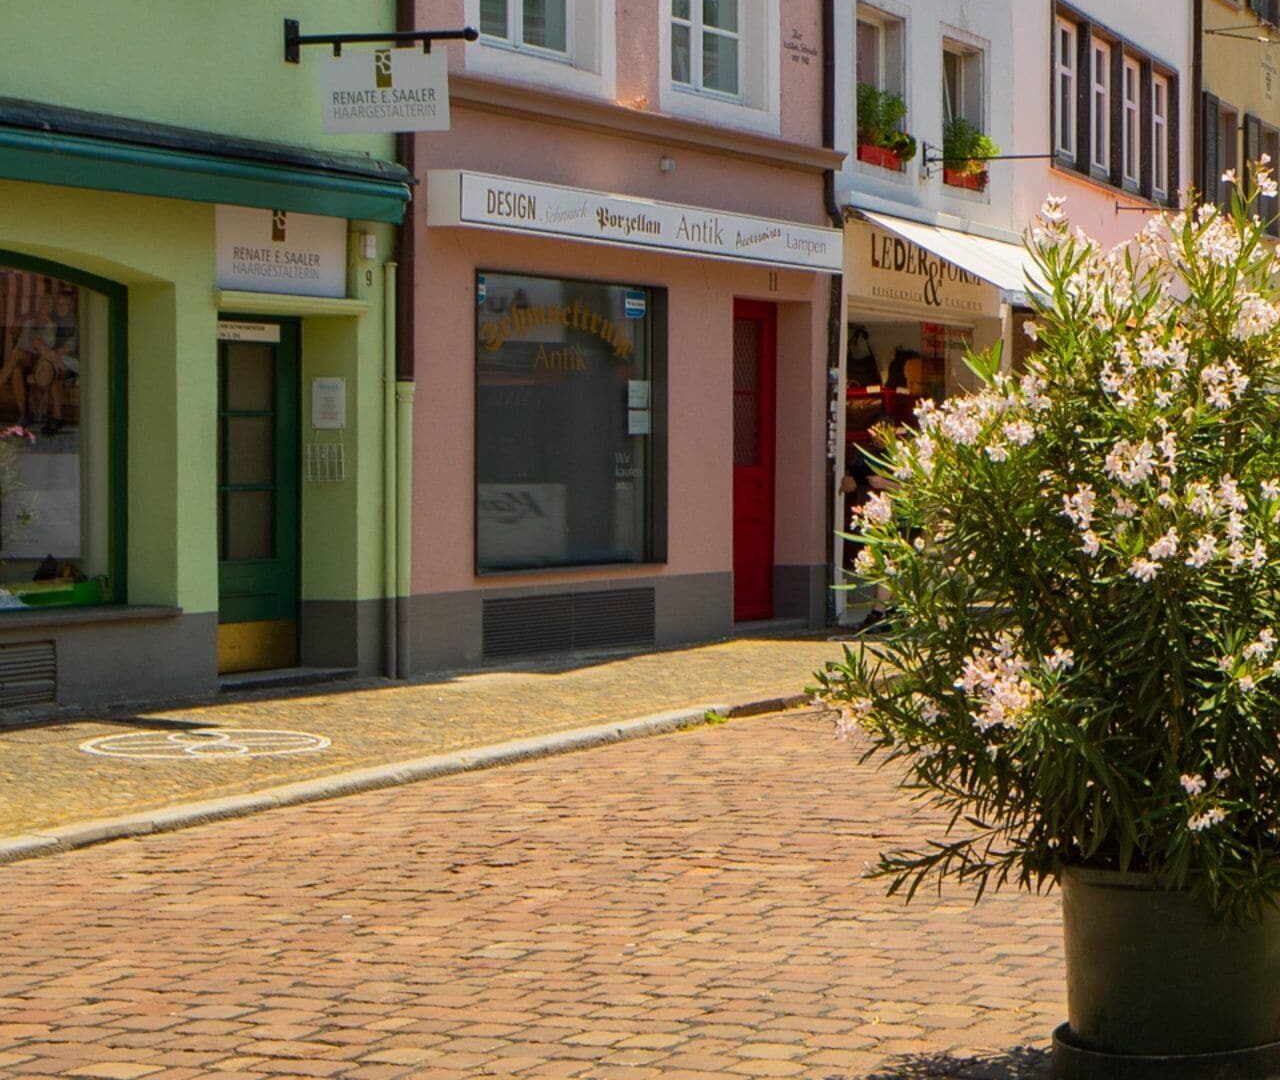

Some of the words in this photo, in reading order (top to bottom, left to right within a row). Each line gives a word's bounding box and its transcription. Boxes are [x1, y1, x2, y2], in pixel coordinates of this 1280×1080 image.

[333, 89, 377, 105] RENATE
[333, 103, 437, 120] HAARGESTALTERIN
[487, 188, 536, 220] DESIGN
[596, 206, 662, 236] Porzellan
[676, 215, 725, 247] Antik
[786, 233, 828, 257] Lampen
[232, 246, 272, 264] RENATE
[871, 232, 929, 276] LEDER
[232, 261, 321, 281] HAARGESTALTERIN
[365, 270, 373, 287] 9
[534, 343, 586, 374] Antik
